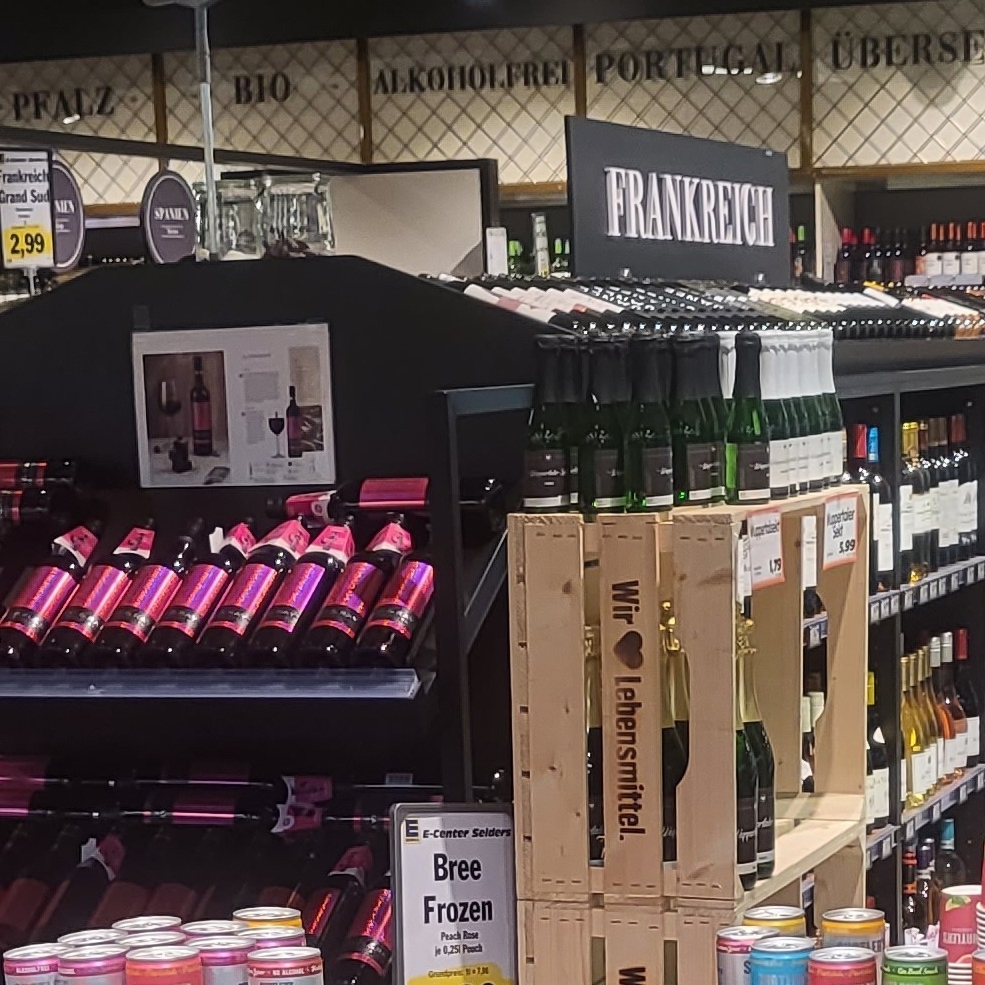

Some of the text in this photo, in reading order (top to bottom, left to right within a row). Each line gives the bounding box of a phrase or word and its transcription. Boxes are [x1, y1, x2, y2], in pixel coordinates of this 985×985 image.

[595, 40, 797, 85] PORTUGAL
[232, 71, 292, 105] BIO
[372, 59, 571, 96] ALKOHOLFREI
[11, 85, 115, 121] PFALZ
[153, 207, 190, 221] SPANIEN
[604, 166, 776, 248] FRANKREICH
[10, 232, 45, 255] 2,99
[611, 579, 646, 841] Wir Lebensmittel.
[423, 827, 512, 839] E-Center Selders
[433, 853, 482, 882] Bree
[423, 896, 493, 924] Frozen
[440, 930, 479, 941] Peach Rose
[462, 944, 483, 953] Pouch
